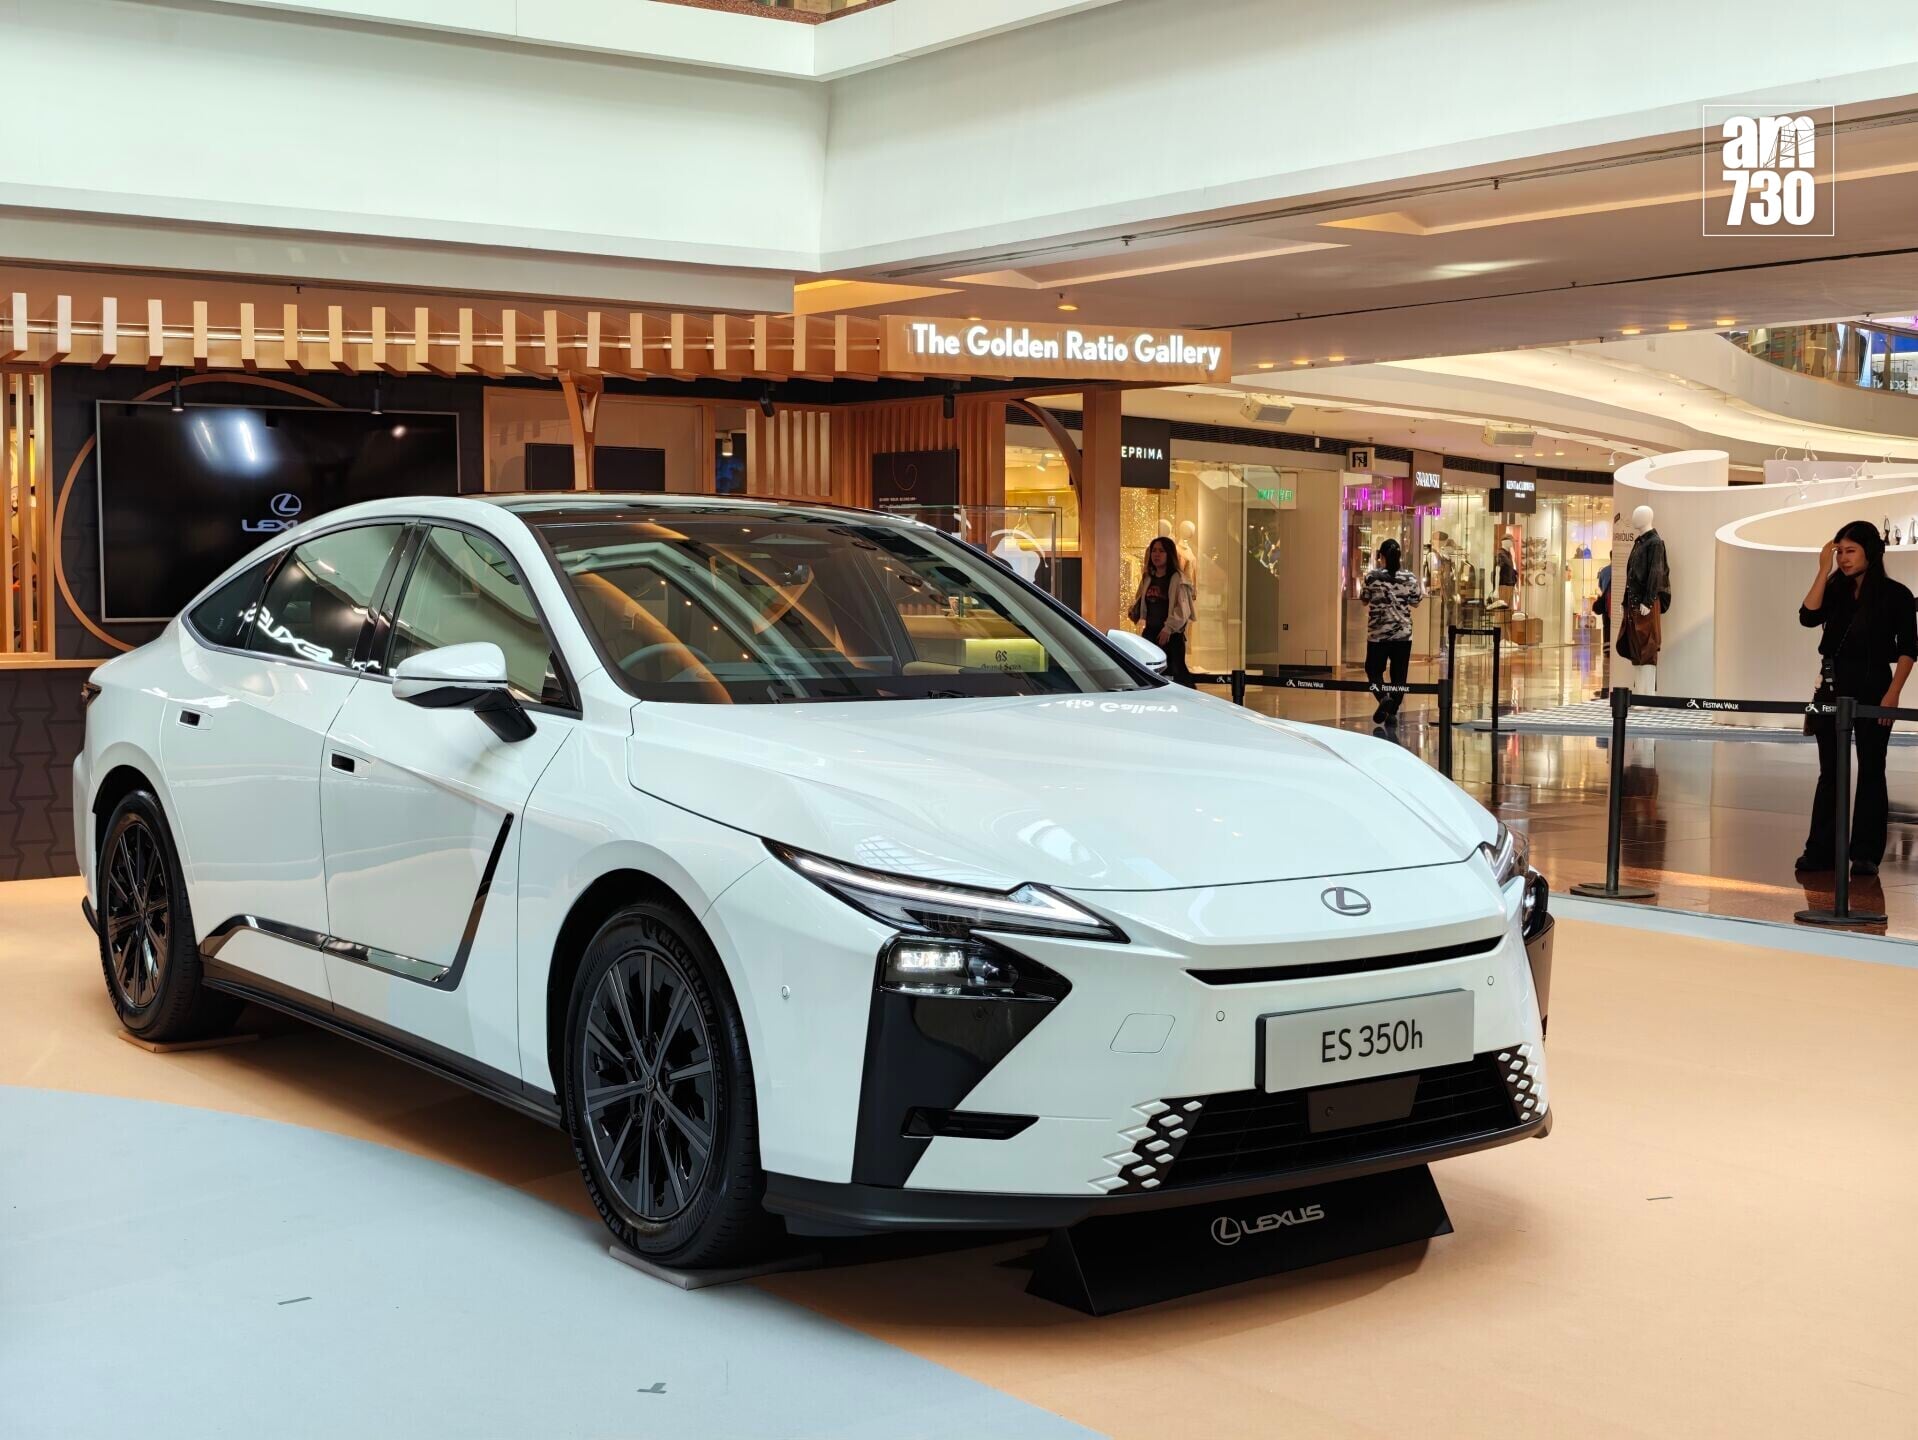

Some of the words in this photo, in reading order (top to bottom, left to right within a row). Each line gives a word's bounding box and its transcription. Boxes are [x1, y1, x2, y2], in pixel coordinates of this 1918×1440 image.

[911, 323, 960, 355] The
[967, 326, 1058, 358] Golden
[1067, 330, 1128, 362] Ratio
[1135, 334, 1221, 370] Gallery
[1724, 702, 1739, 710] WALK
[1322, 1028, 1352, 1063] ES
[1358, 1019, 1423, 1057] 350h
[1241, 1204, 1325, 1235] LEXUS
